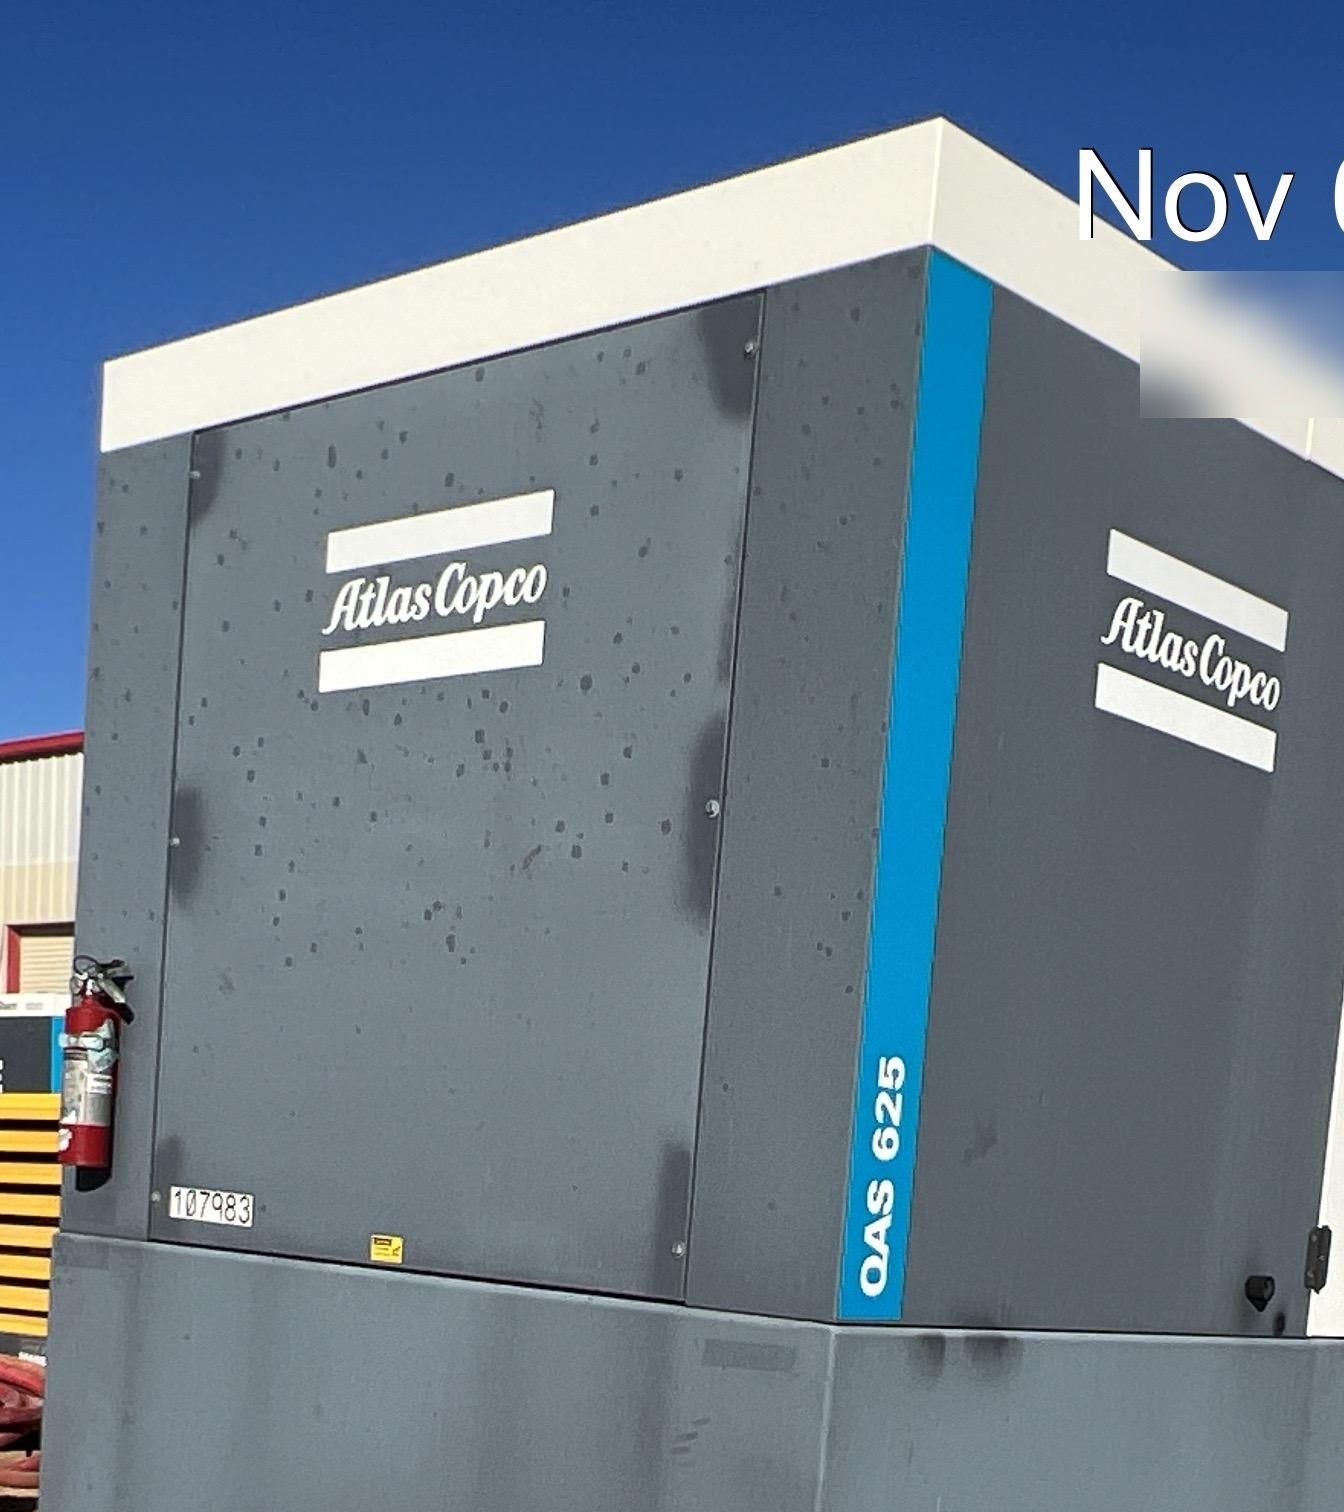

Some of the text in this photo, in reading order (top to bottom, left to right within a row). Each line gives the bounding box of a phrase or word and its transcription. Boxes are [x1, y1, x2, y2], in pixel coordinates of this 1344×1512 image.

[321, 561, 548, 635] Atlas Copco
[1100, 597, 1281, 711] Atlas Copco
[174, 1189, 250, 1224] 107983
[859, 1056, 906, 1297] QAS 625
